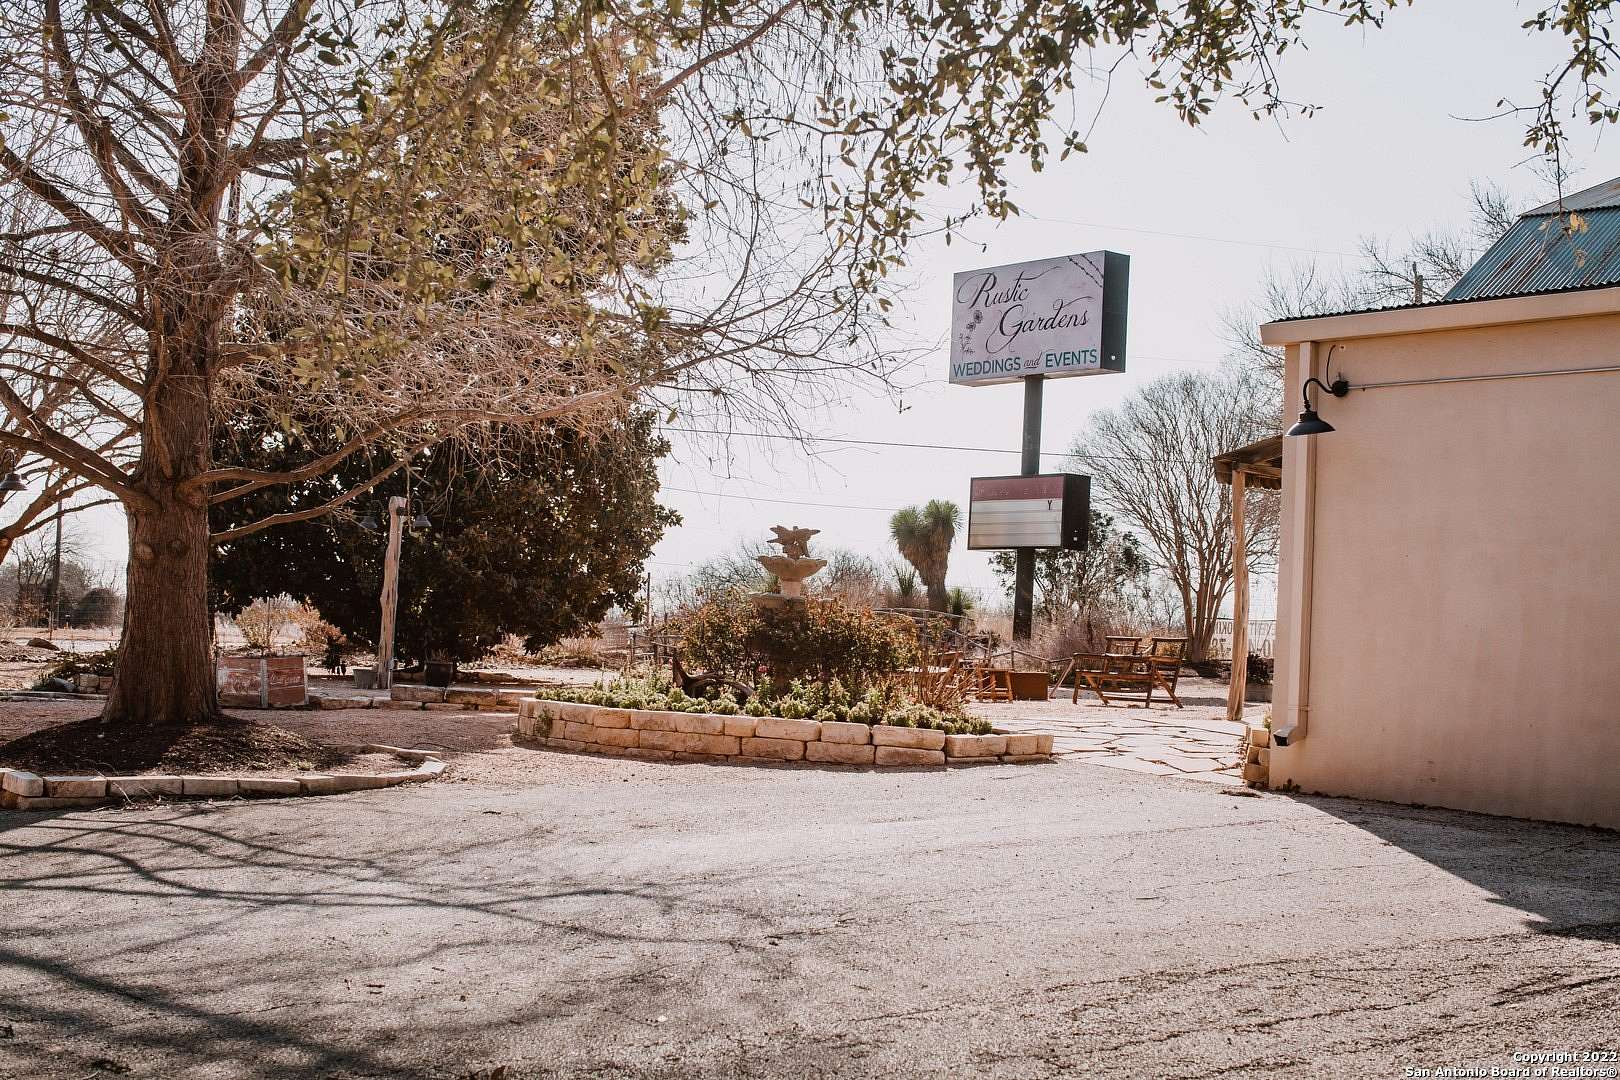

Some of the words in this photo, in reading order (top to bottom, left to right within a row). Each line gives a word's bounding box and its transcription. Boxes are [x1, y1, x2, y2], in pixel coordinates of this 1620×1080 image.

[957, 267, 1060, 309] Rustic
[986, 296, 1093, 353] Gardens
[953, 357, 1021, 377] WEDDINGS
[1024, 352, 1043, 369] and
[1045, 349, 1097, 368] EVENTS
